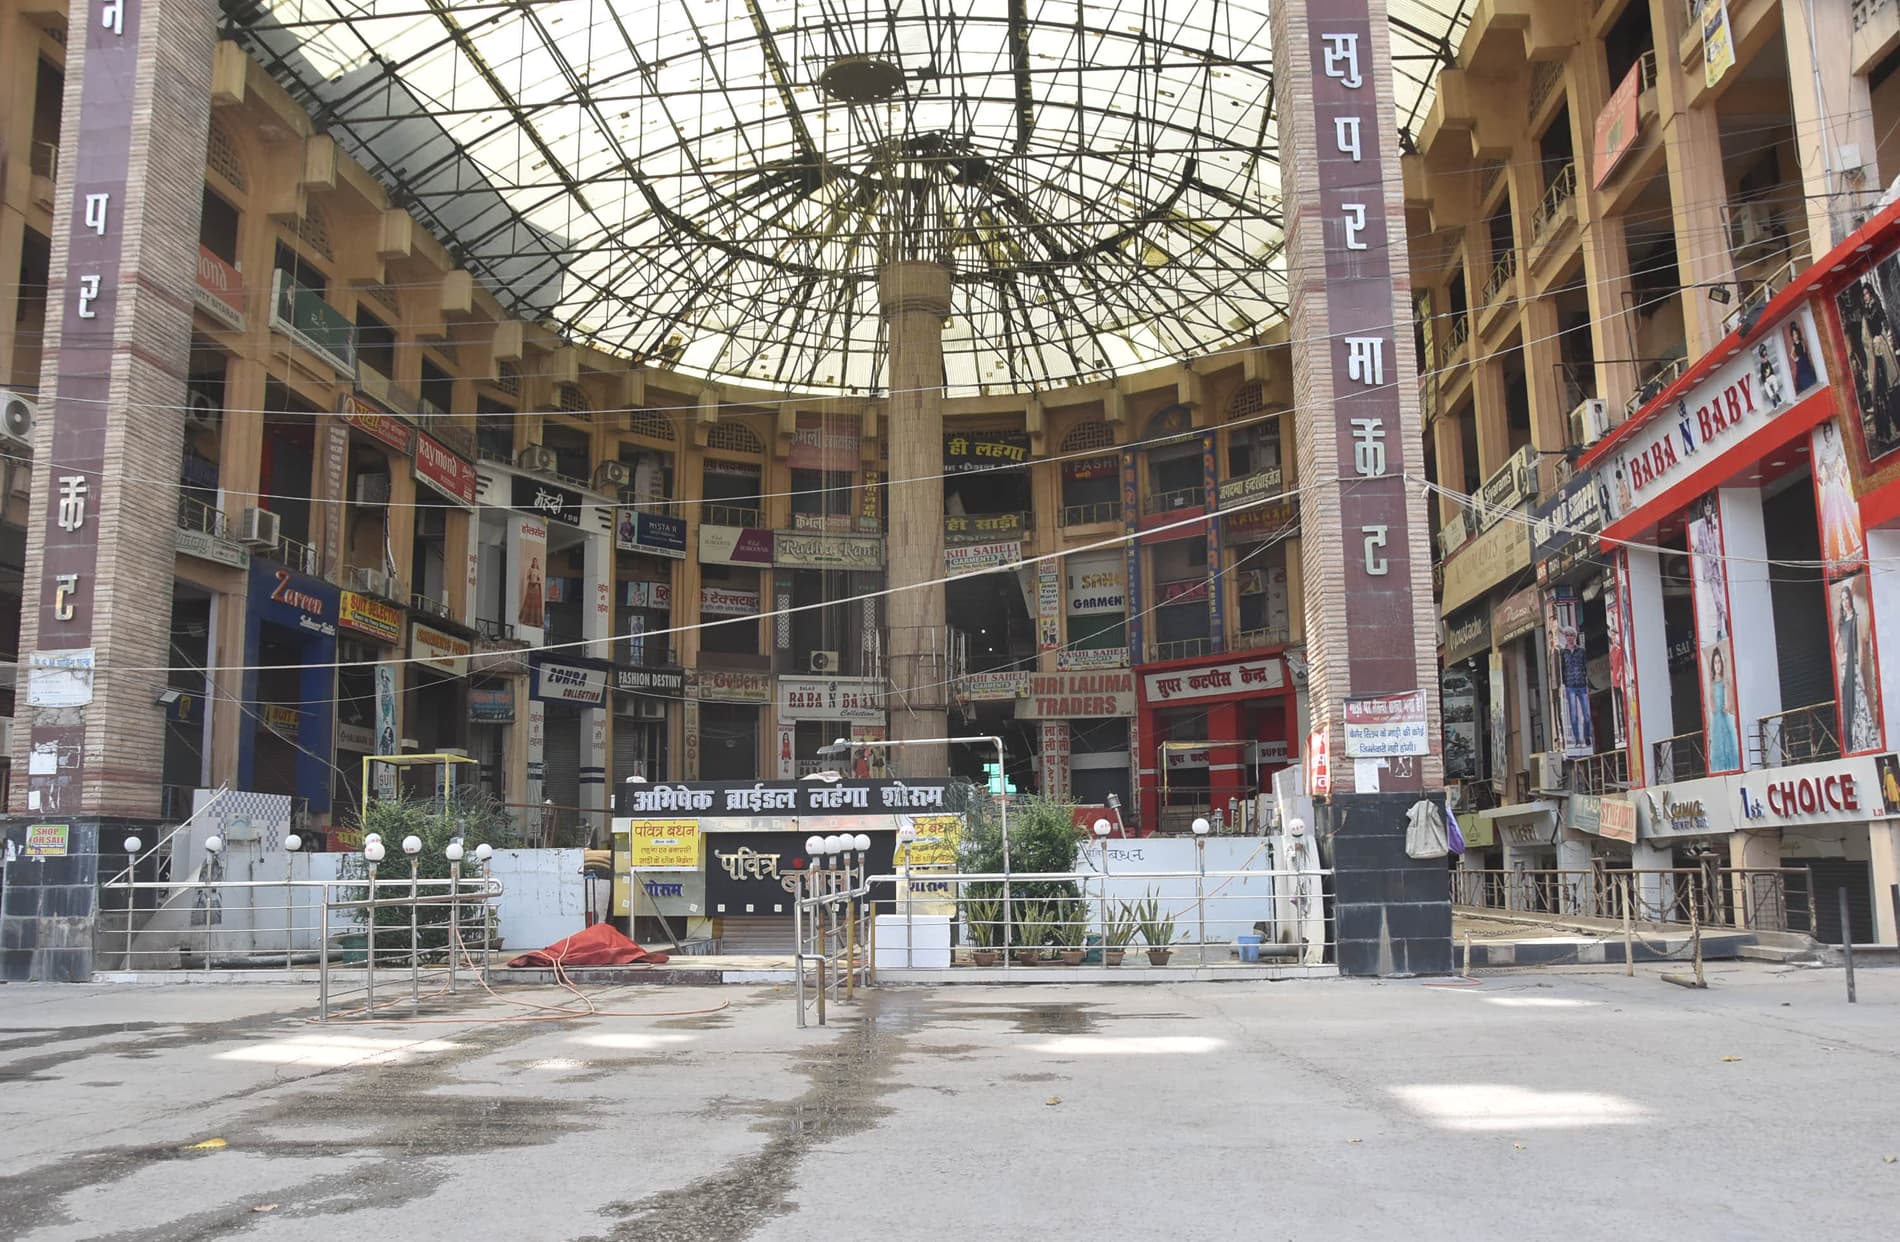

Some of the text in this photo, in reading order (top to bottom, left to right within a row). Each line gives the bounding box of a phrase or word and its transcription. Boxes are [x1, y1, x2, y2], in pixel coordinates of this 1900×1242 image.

[1629, 373, 1758, 490] BABA N BABY
[418, 438, 457, 477] Raymond
[948, 438, 1027, 461] ही लहंगा
[975, 514, 1020, 532] साड़ी
[944, 543, 1018, 560] KHI SAHELI
[271, 569, 323, 615] Zareen
[1093, 648, 1129, 658] SAHELI
[547, 668, 588, 687] ZOHRA
[618, 671, 682, 688] FASHION DESTINY
[991, 671, 1028, 683] SAHELI
[1069, 674, 1133, 694] LALIMA
[1157, 666, 1266, 697] सुपर कटपीस केन्द्र
[789, 692, 822, 708] BABA
[829, 693, 836, 708] N
[1035, 696, 1117, 715] TRADERS
[840, 709, 875, 717] Collection
[379, 775, 395, 786] SUIT
[633, 785, 715, 812] अभिषेक
[724, 783, 798, 812] ब्राईडल
[808, 783, 870, 809] लहंगा
[1740, 774, 1858, 819] 1st CHOICE
[635, 822, 696, 838] पवित्र बंधन
[714, 847, 781, 881] पवित्र
